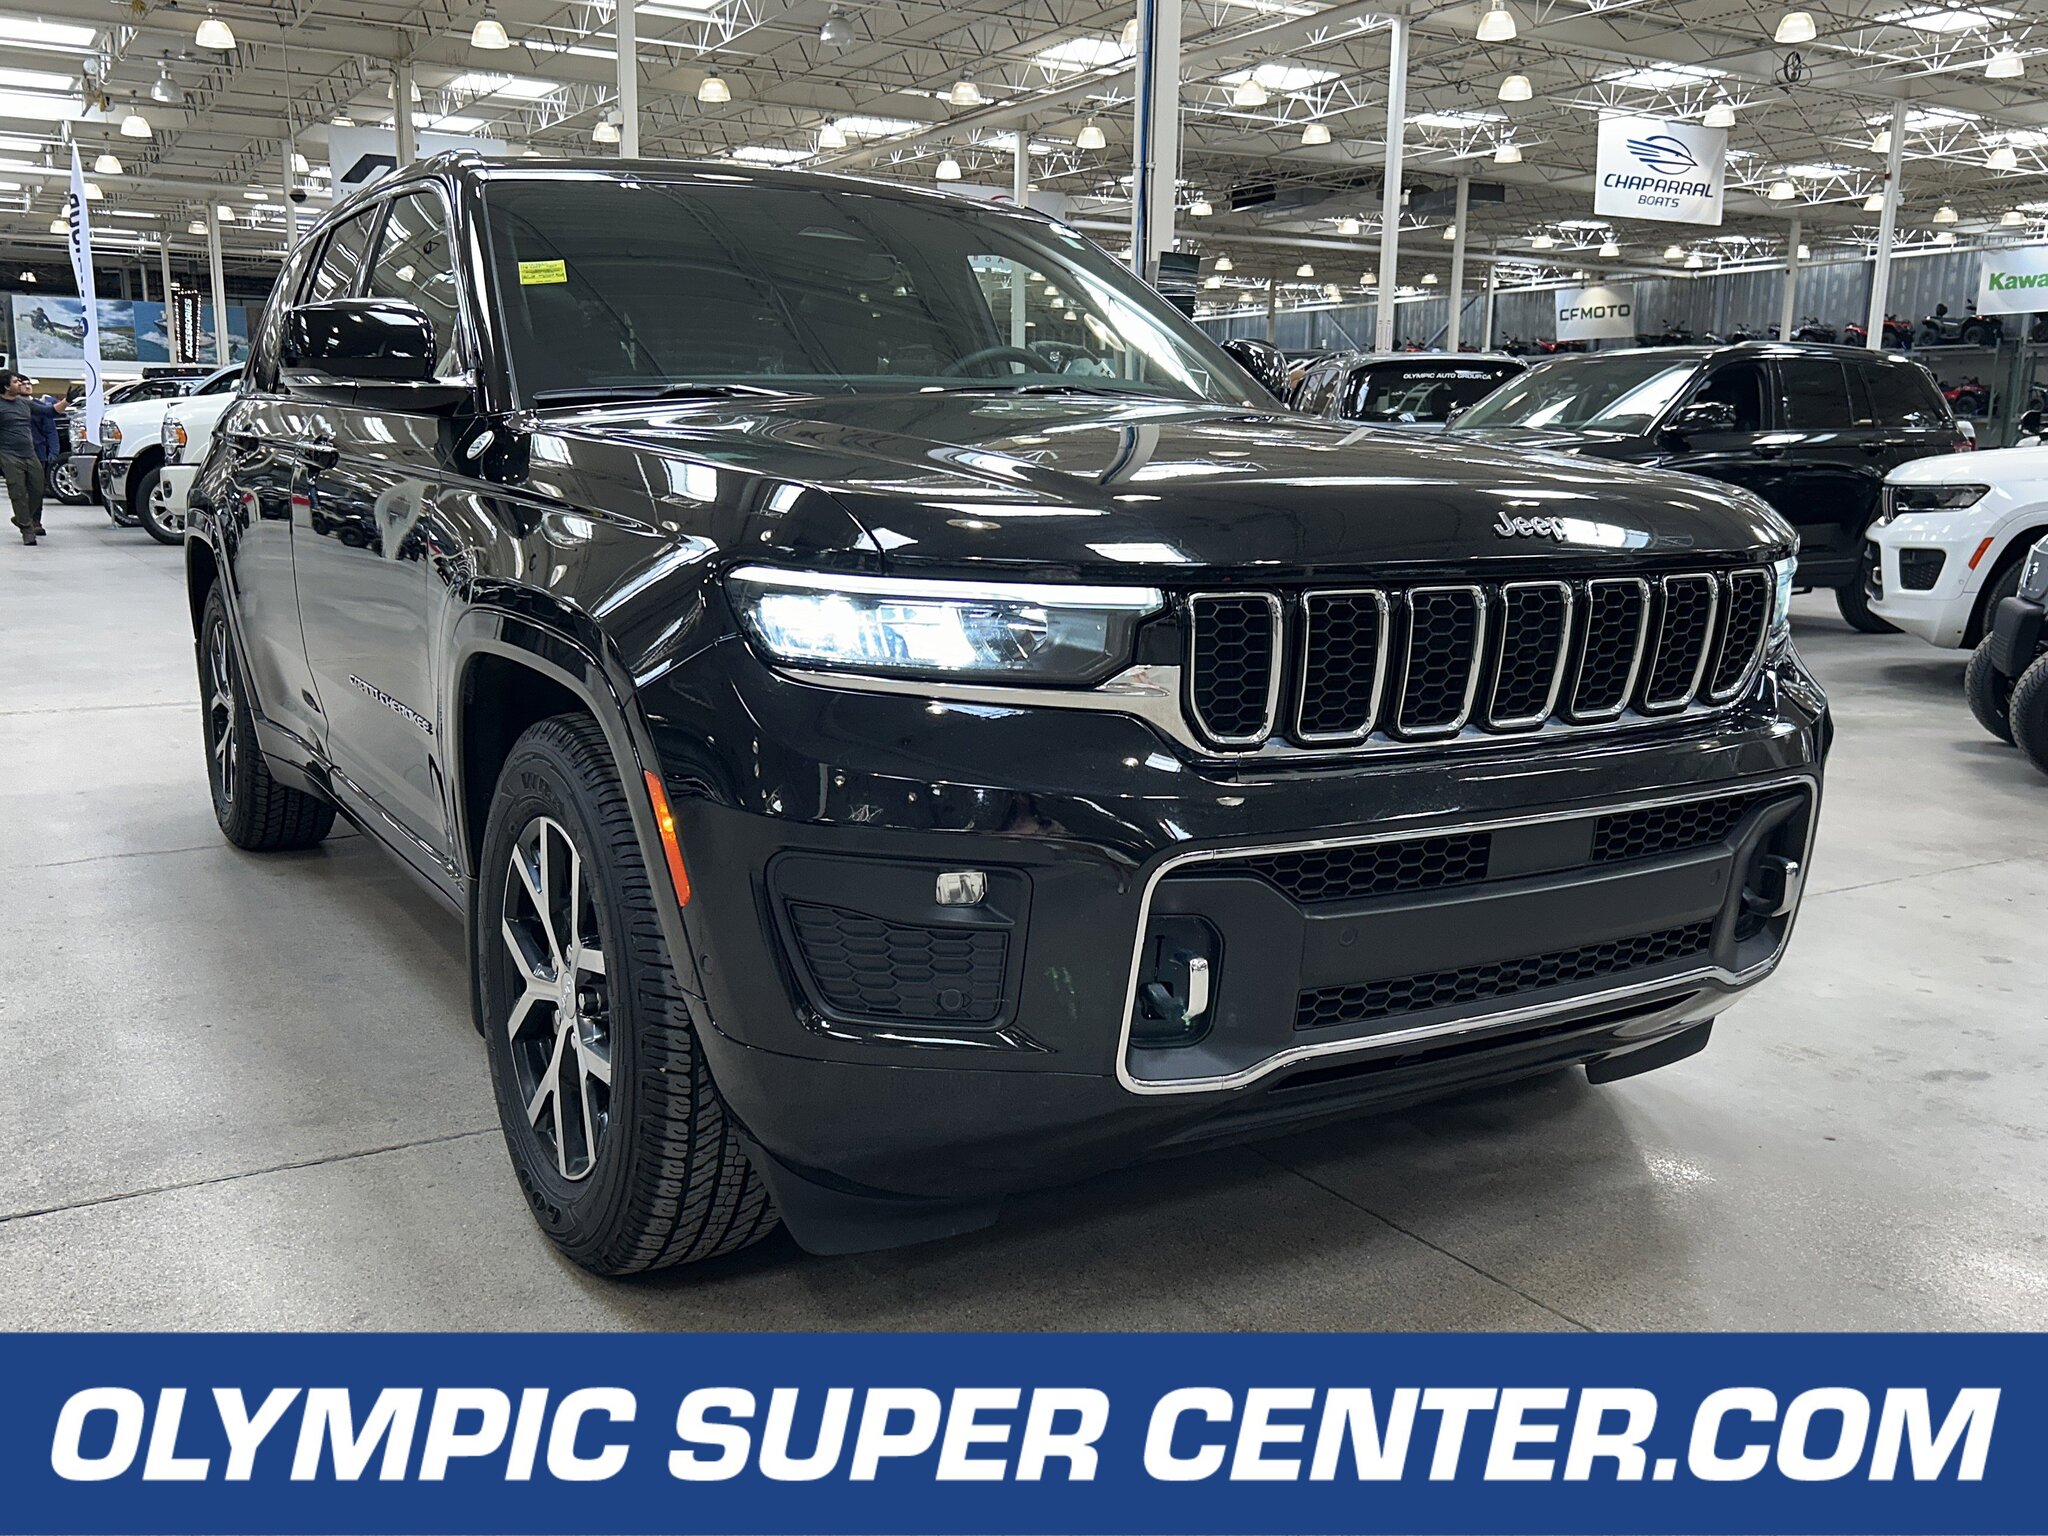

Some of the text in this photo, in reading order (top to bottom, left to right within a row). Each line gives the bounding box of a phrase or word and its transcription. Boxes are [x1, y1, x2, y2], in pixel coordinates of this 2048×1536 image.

[1603, 173, 1714, 198] CHAPARRAL
[1638, 194, 1680, 208] BOATS
[1559, 304, 1631, 321] CFMOTO
[184, 297, 194, 359] ACCESSORIES
[1494, 511, 1566, 542] Jeep
